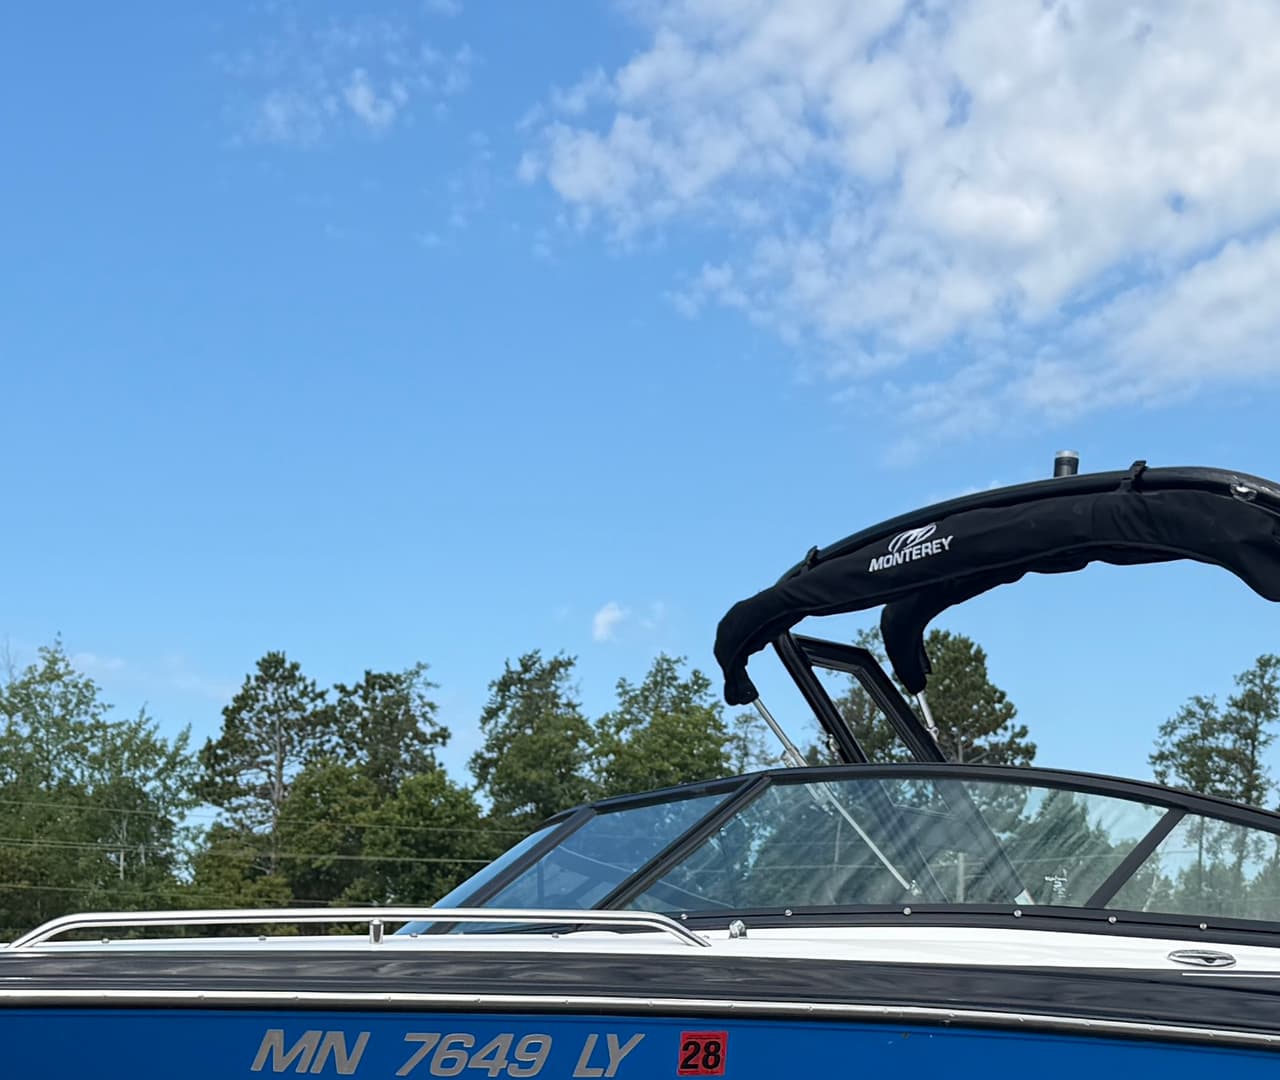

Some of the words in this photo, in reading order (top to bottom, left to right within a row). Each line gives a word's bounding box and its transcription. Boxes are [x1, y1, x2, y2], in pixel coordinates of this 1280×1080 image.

[869, 535, 953, 572] MONTEREY
[250, 1028, 371, 1075] MN
[395, 1032, 552, 1078] 7649
[572, 1032, 646, 1079] LY
[680, 1040, 721, 1070] 28
